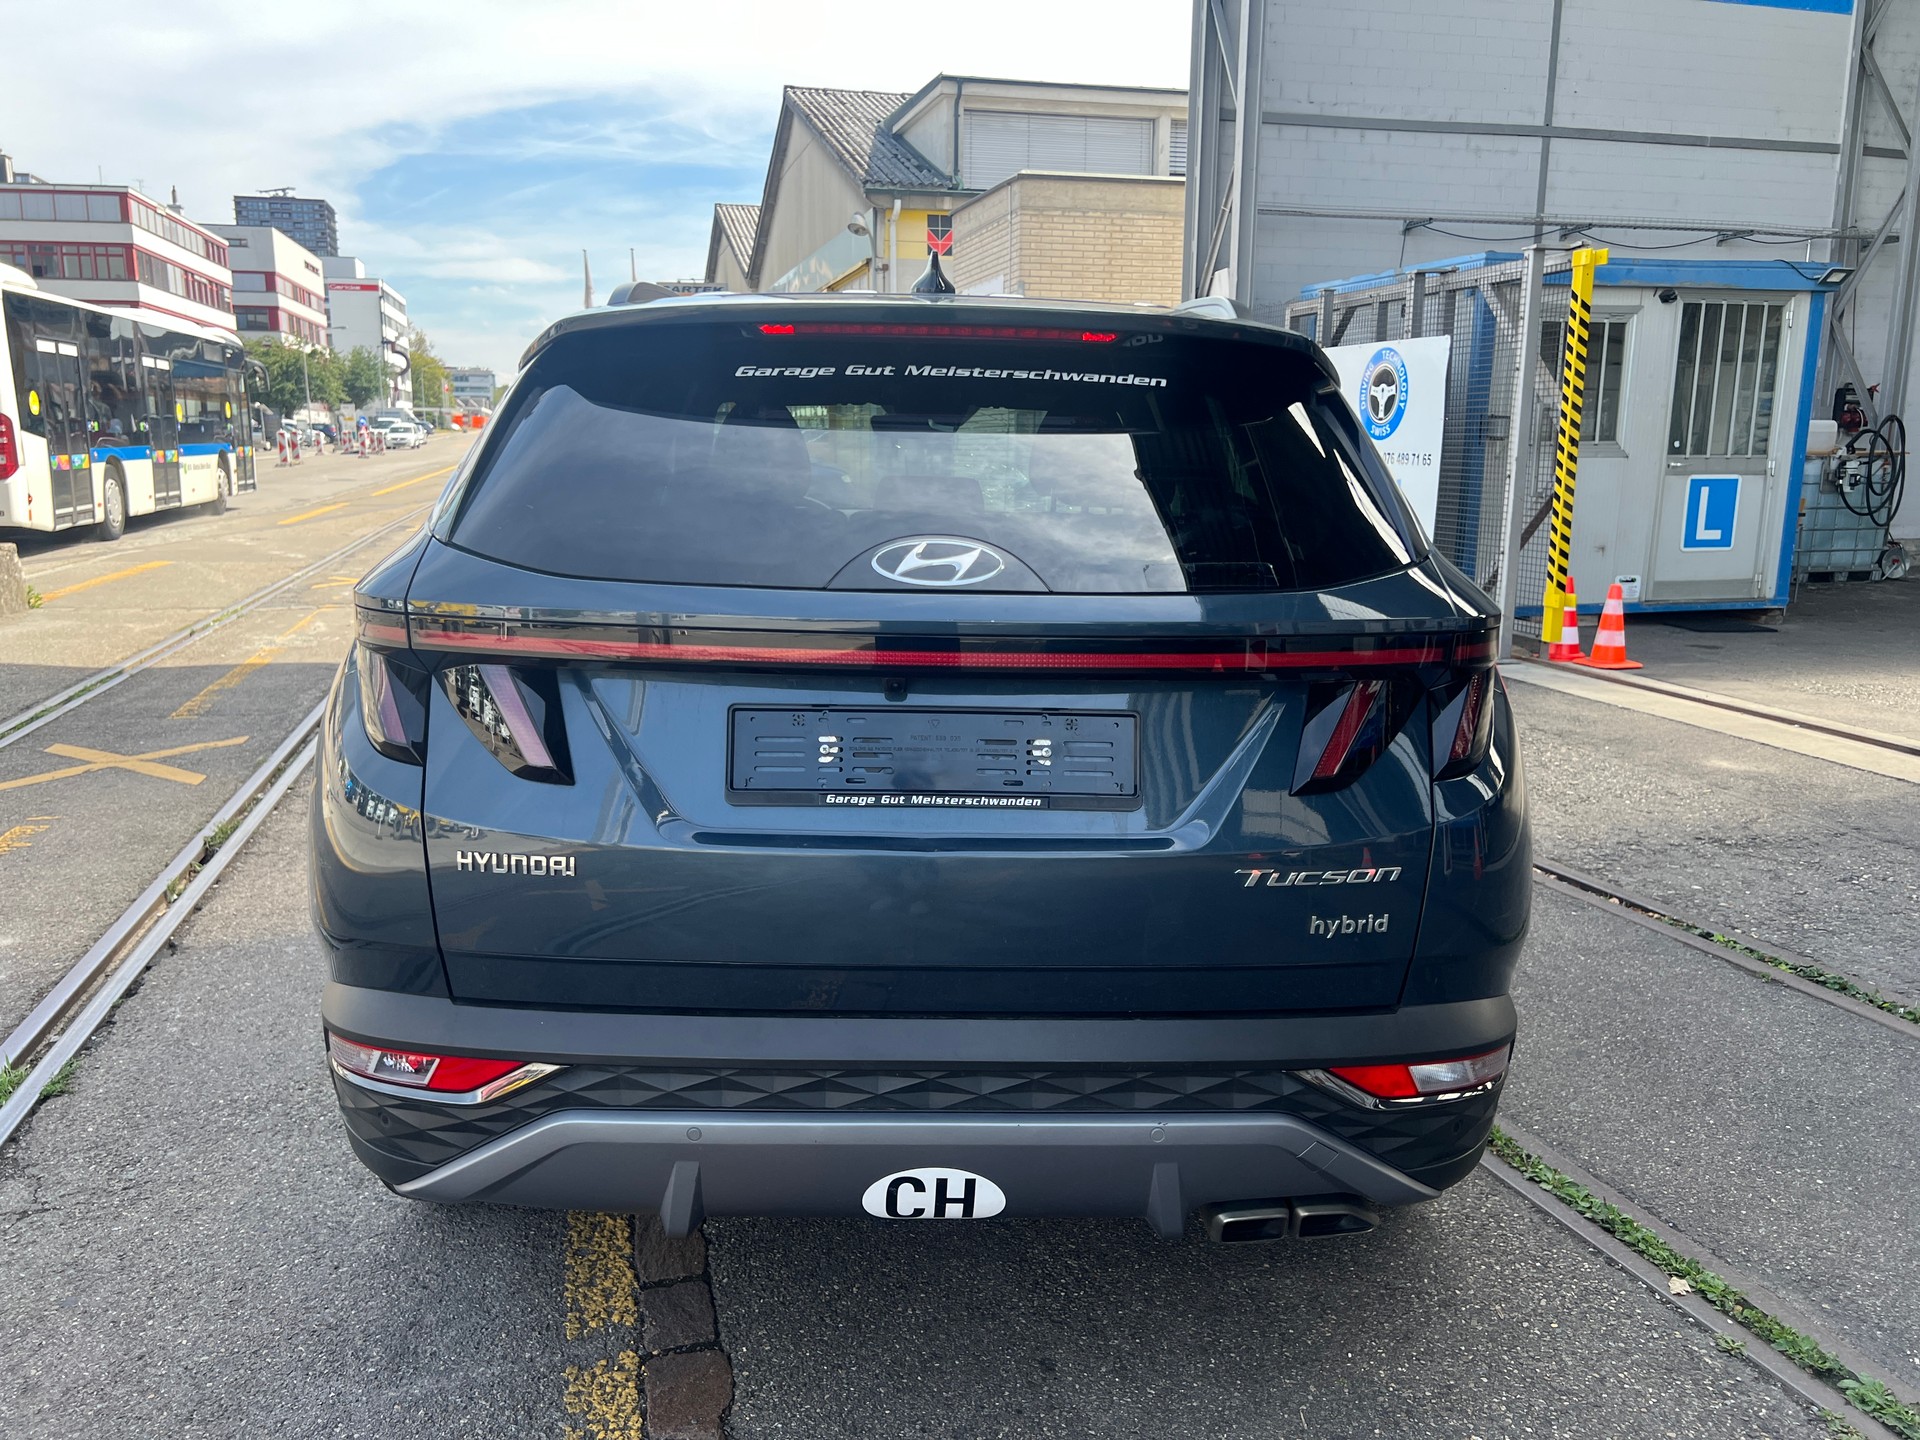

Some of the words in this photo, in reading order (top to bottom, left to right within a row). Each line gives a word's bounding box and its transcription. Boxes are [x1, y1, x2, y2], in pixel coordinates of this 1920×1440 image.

[735, 365, 836, 379] Garage
[845, 364, 895, 376] Gut
[904, 365, 1168, 387] Meisterschwanden
[1360, 363, 1375, 410] DRIVING
[1382, 350, 1408, 410] TECHNOLOGY
[1370, 423, 1391, 437] SWISS
[1396, 452, 1409, 465] 489
[1411, 453, 1420, 466] 71
[1422, 453, 1433, 466] 65
[1696, 486, 1722, 540] L
[826, 794, 876, 806] Garage
[880, 795, 906, 804] Gut
[910, 795, 1042, 807] Meisterschwanden
[456, 850, 576, 877] HYUNDAI
[1309, 913, 1390, 939] hybrid
[885, 1176, 977, 1218] CH
